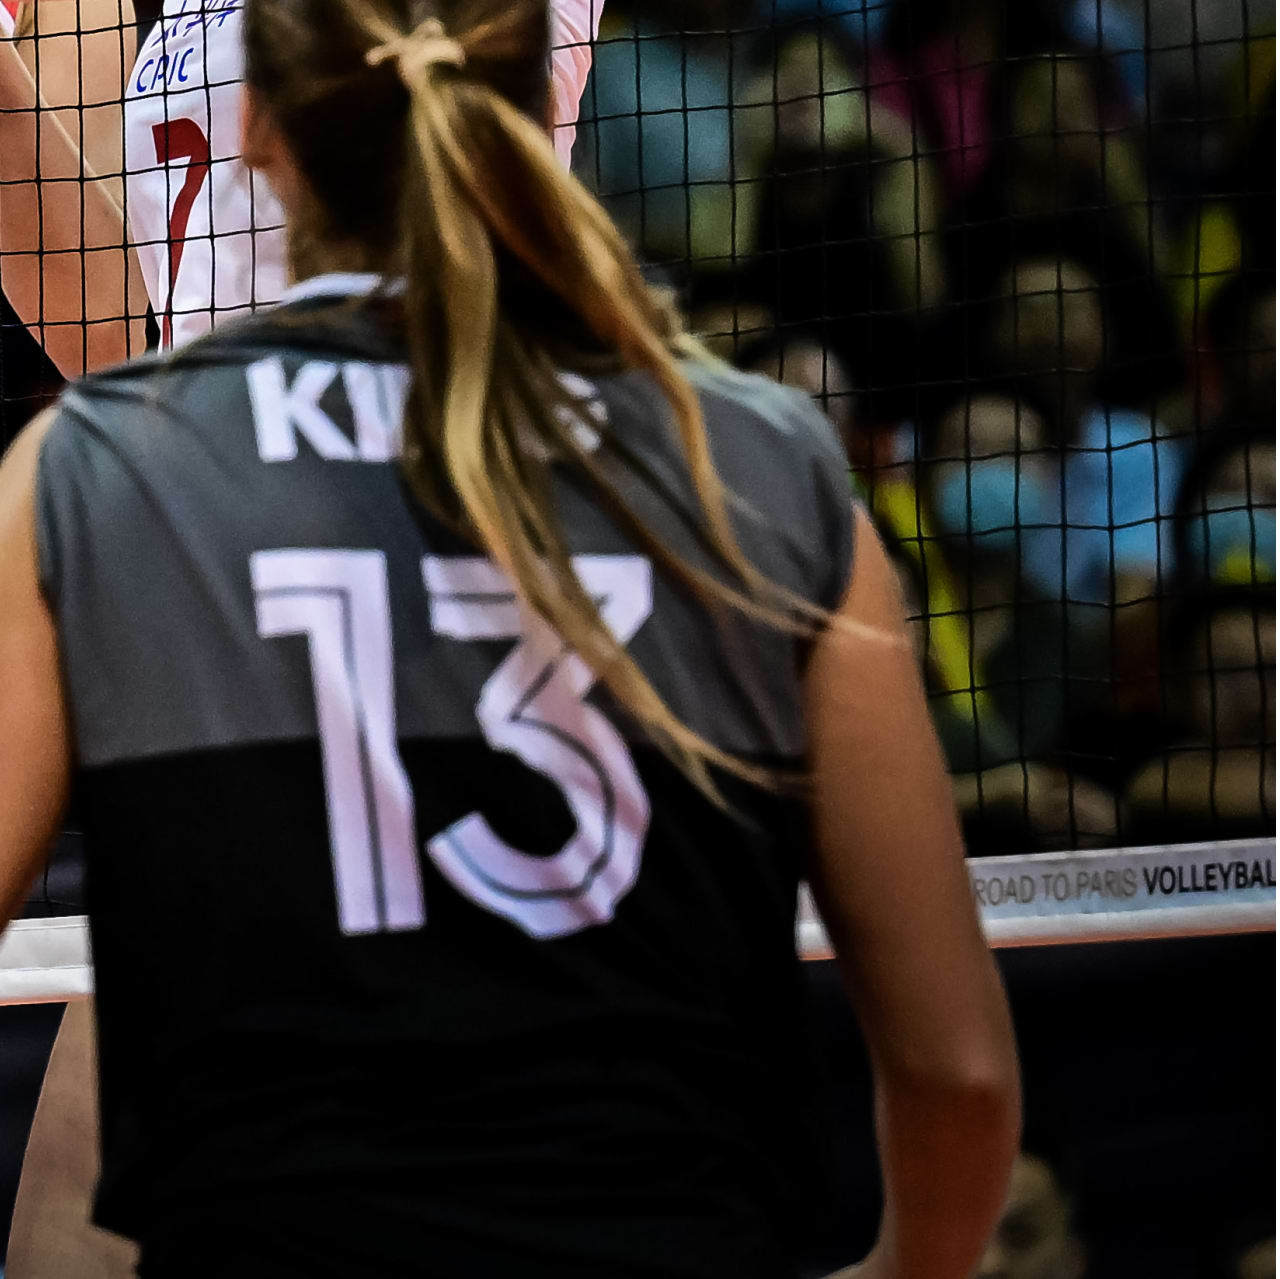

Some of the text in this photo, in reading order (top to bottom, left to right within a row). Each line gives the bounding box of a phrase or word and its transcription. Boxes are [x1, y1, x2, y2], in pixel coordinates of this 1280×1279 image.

[136, 48, 194, 93] CPIC
[251, 550, 652, 939] 13
[975, 875, 1036, 906] ROAD
[1042, 873, 1069, 901] TO
[1077, 869, 1138, 899] PARIS
